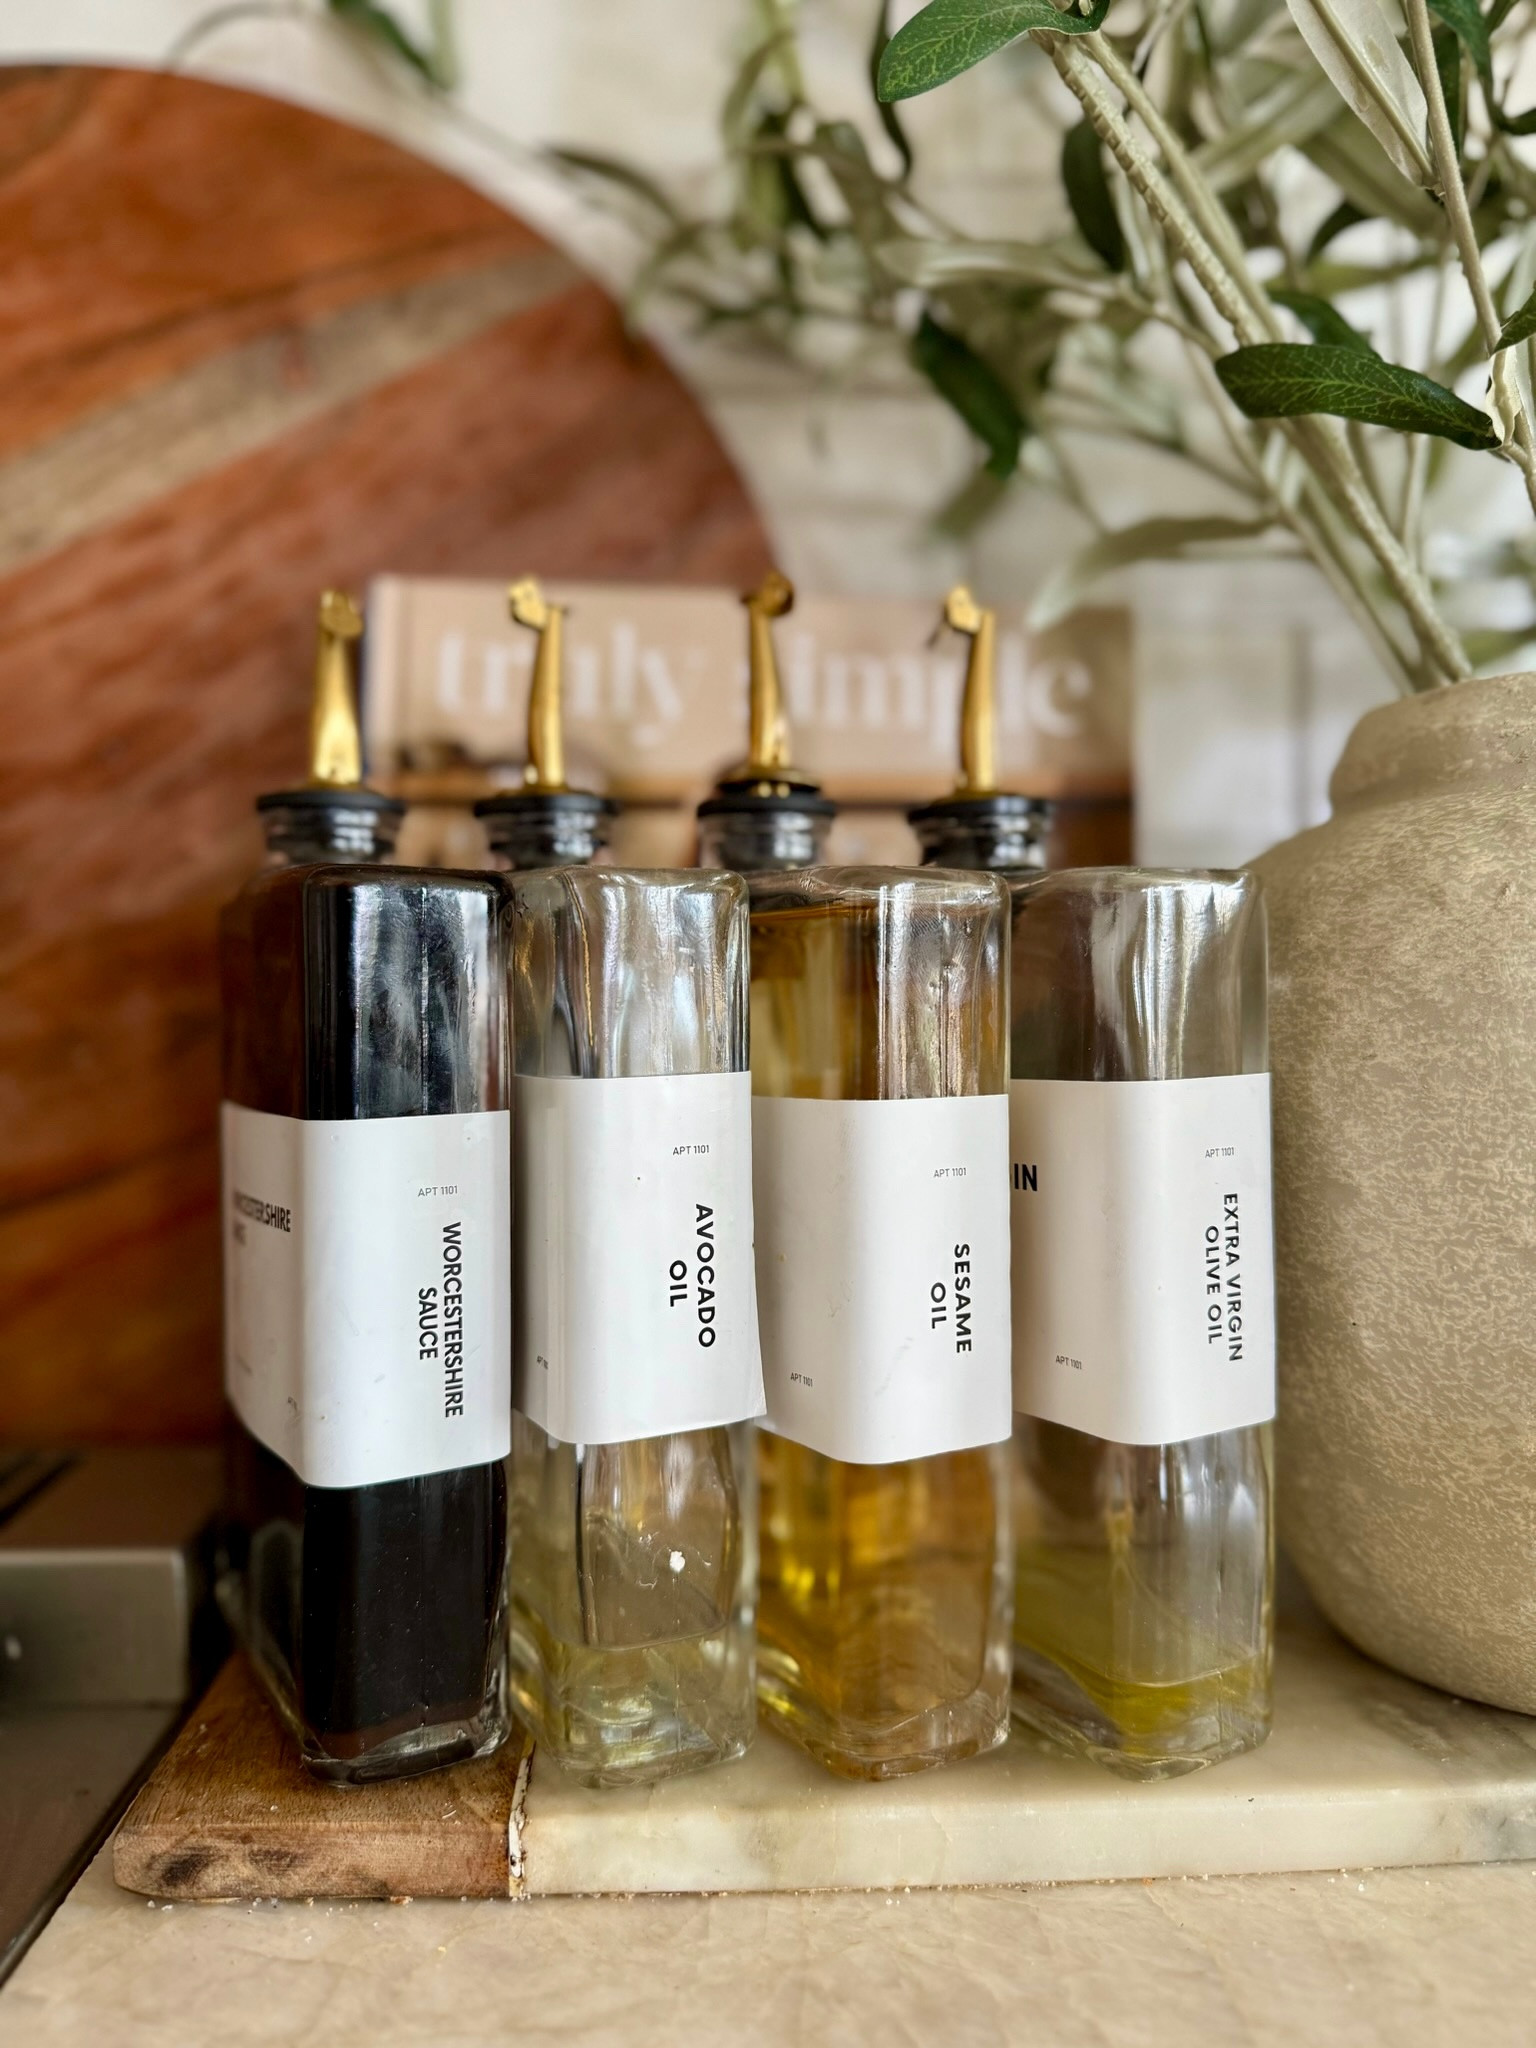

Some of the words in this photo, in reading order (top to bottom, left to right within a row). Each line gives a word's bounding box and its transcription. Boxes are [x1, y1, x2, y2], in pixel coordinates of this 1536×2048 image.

[672, 1145, 691, 1156] APT
[693, 1144, 709, 1154] 1101
[933, 1168, 950, 1179] APT
[951, 1167, 967, 1177] 1101
[1204, 1148, 1220, 1159] APT
[1221, 1146, 1235, 1157] 1101
[417, 1186, 438, 1198] APT
[440, 1185, 458, 1196] 1101
[1223, 1193, 1240, 1267] EXTRA
[669, 1259, 688, 1308] OIL
[695, 1203, 716, 1348] AVOCADO
[1205, 1225, 1221, 1295] OLIVE
[442, 1221, 464, 1418] WORCESTERSHIRE
[930, 1282, 947, 1329] OIL
[954, 1243, 972, 1354] SESAME
[1226, 1273, 1243, 1362] VIRGIN
[418, 1286, 439, 1361] SAUCE
[1207, 1303, 1223, 1344] OIL
[790, 1372, 802, 1384] APT
[1055, 1354, 1069, 1366] APT
